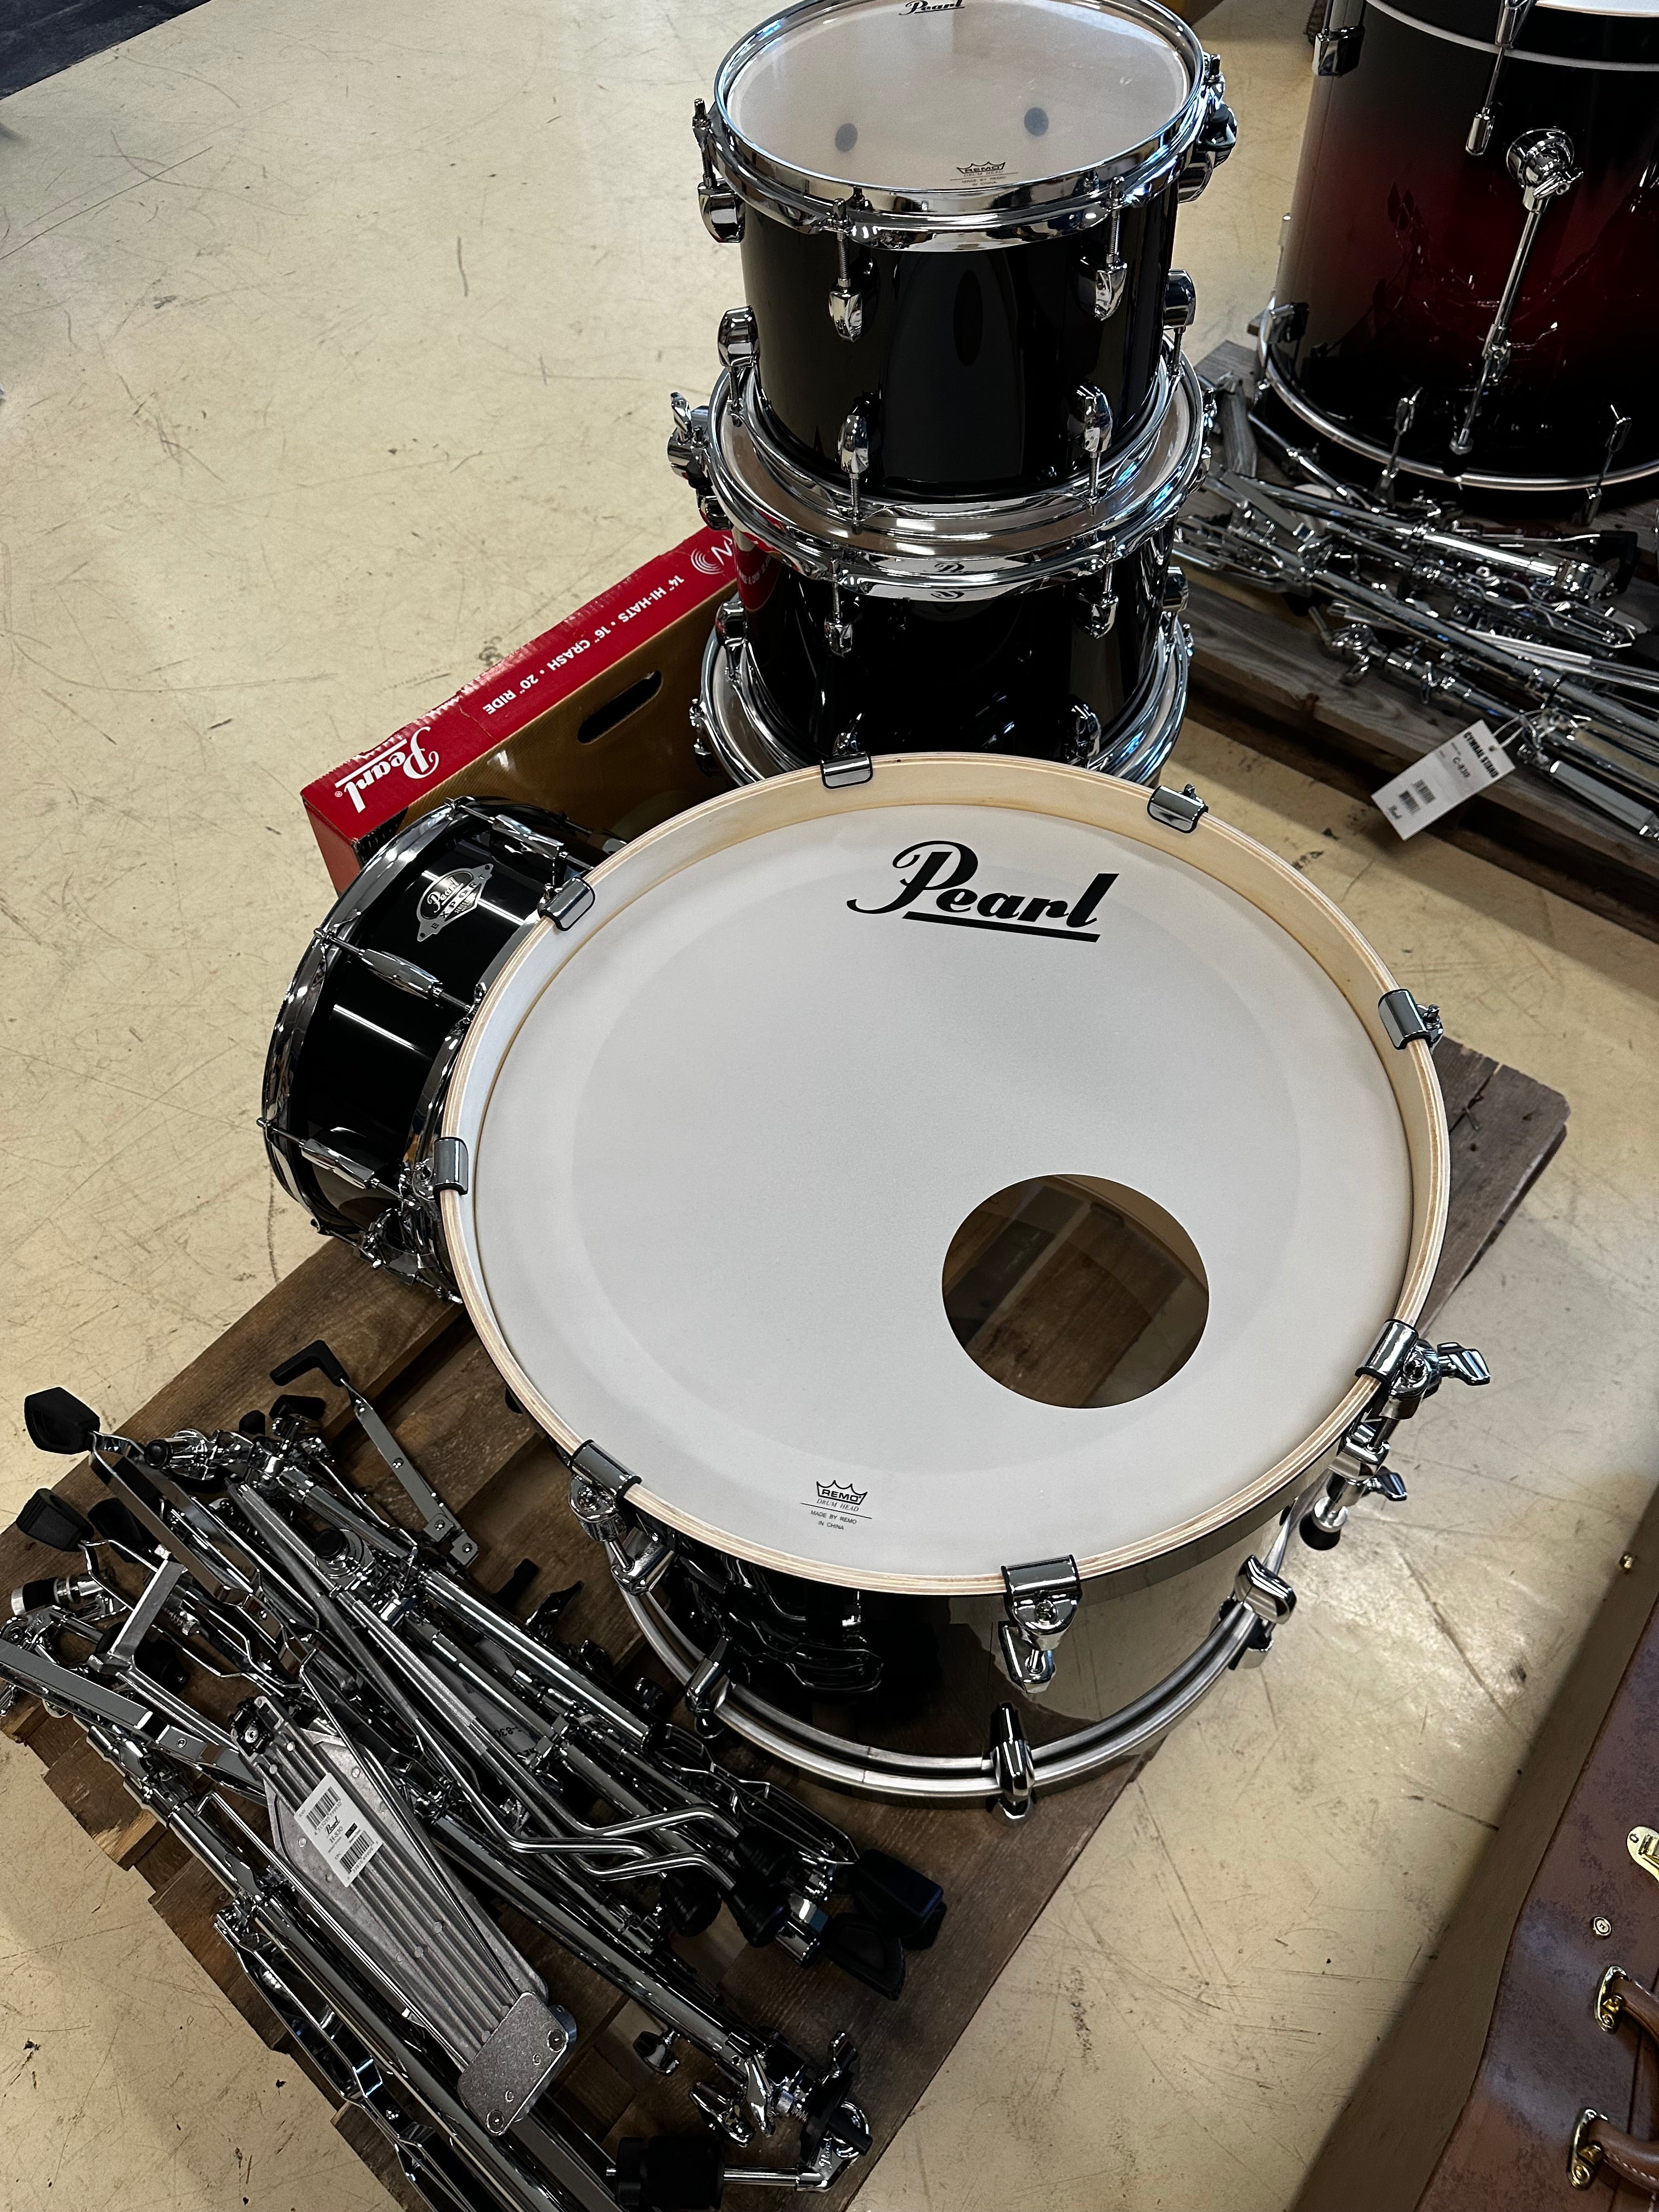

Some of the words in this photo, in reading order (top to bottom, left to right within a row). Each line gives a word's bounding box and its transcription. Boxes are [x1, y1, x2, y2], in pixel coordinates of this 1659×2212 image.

[898, 0, 964, 15] Pearl
[617, 586, 667, 623] HI-HATS
[546, 639, 591, 671] CRASH
[482, 690, 517, 715] RIDE
[341, 726, 439, 814] Pearl
[427, 876, 463, 913] Pearl
[431, 873, 486, 929] EXPORT
[847, 840, 1120, 935] Pearl
[816, 1498, 838, 1508] DRUM
[839, 1503, 860, 1512] HEAD
[821, 1488, 859, 1502] REMO
[811, 1510, 827, 1518] MADE
[325, 1815, 340, 1838] Pearl
